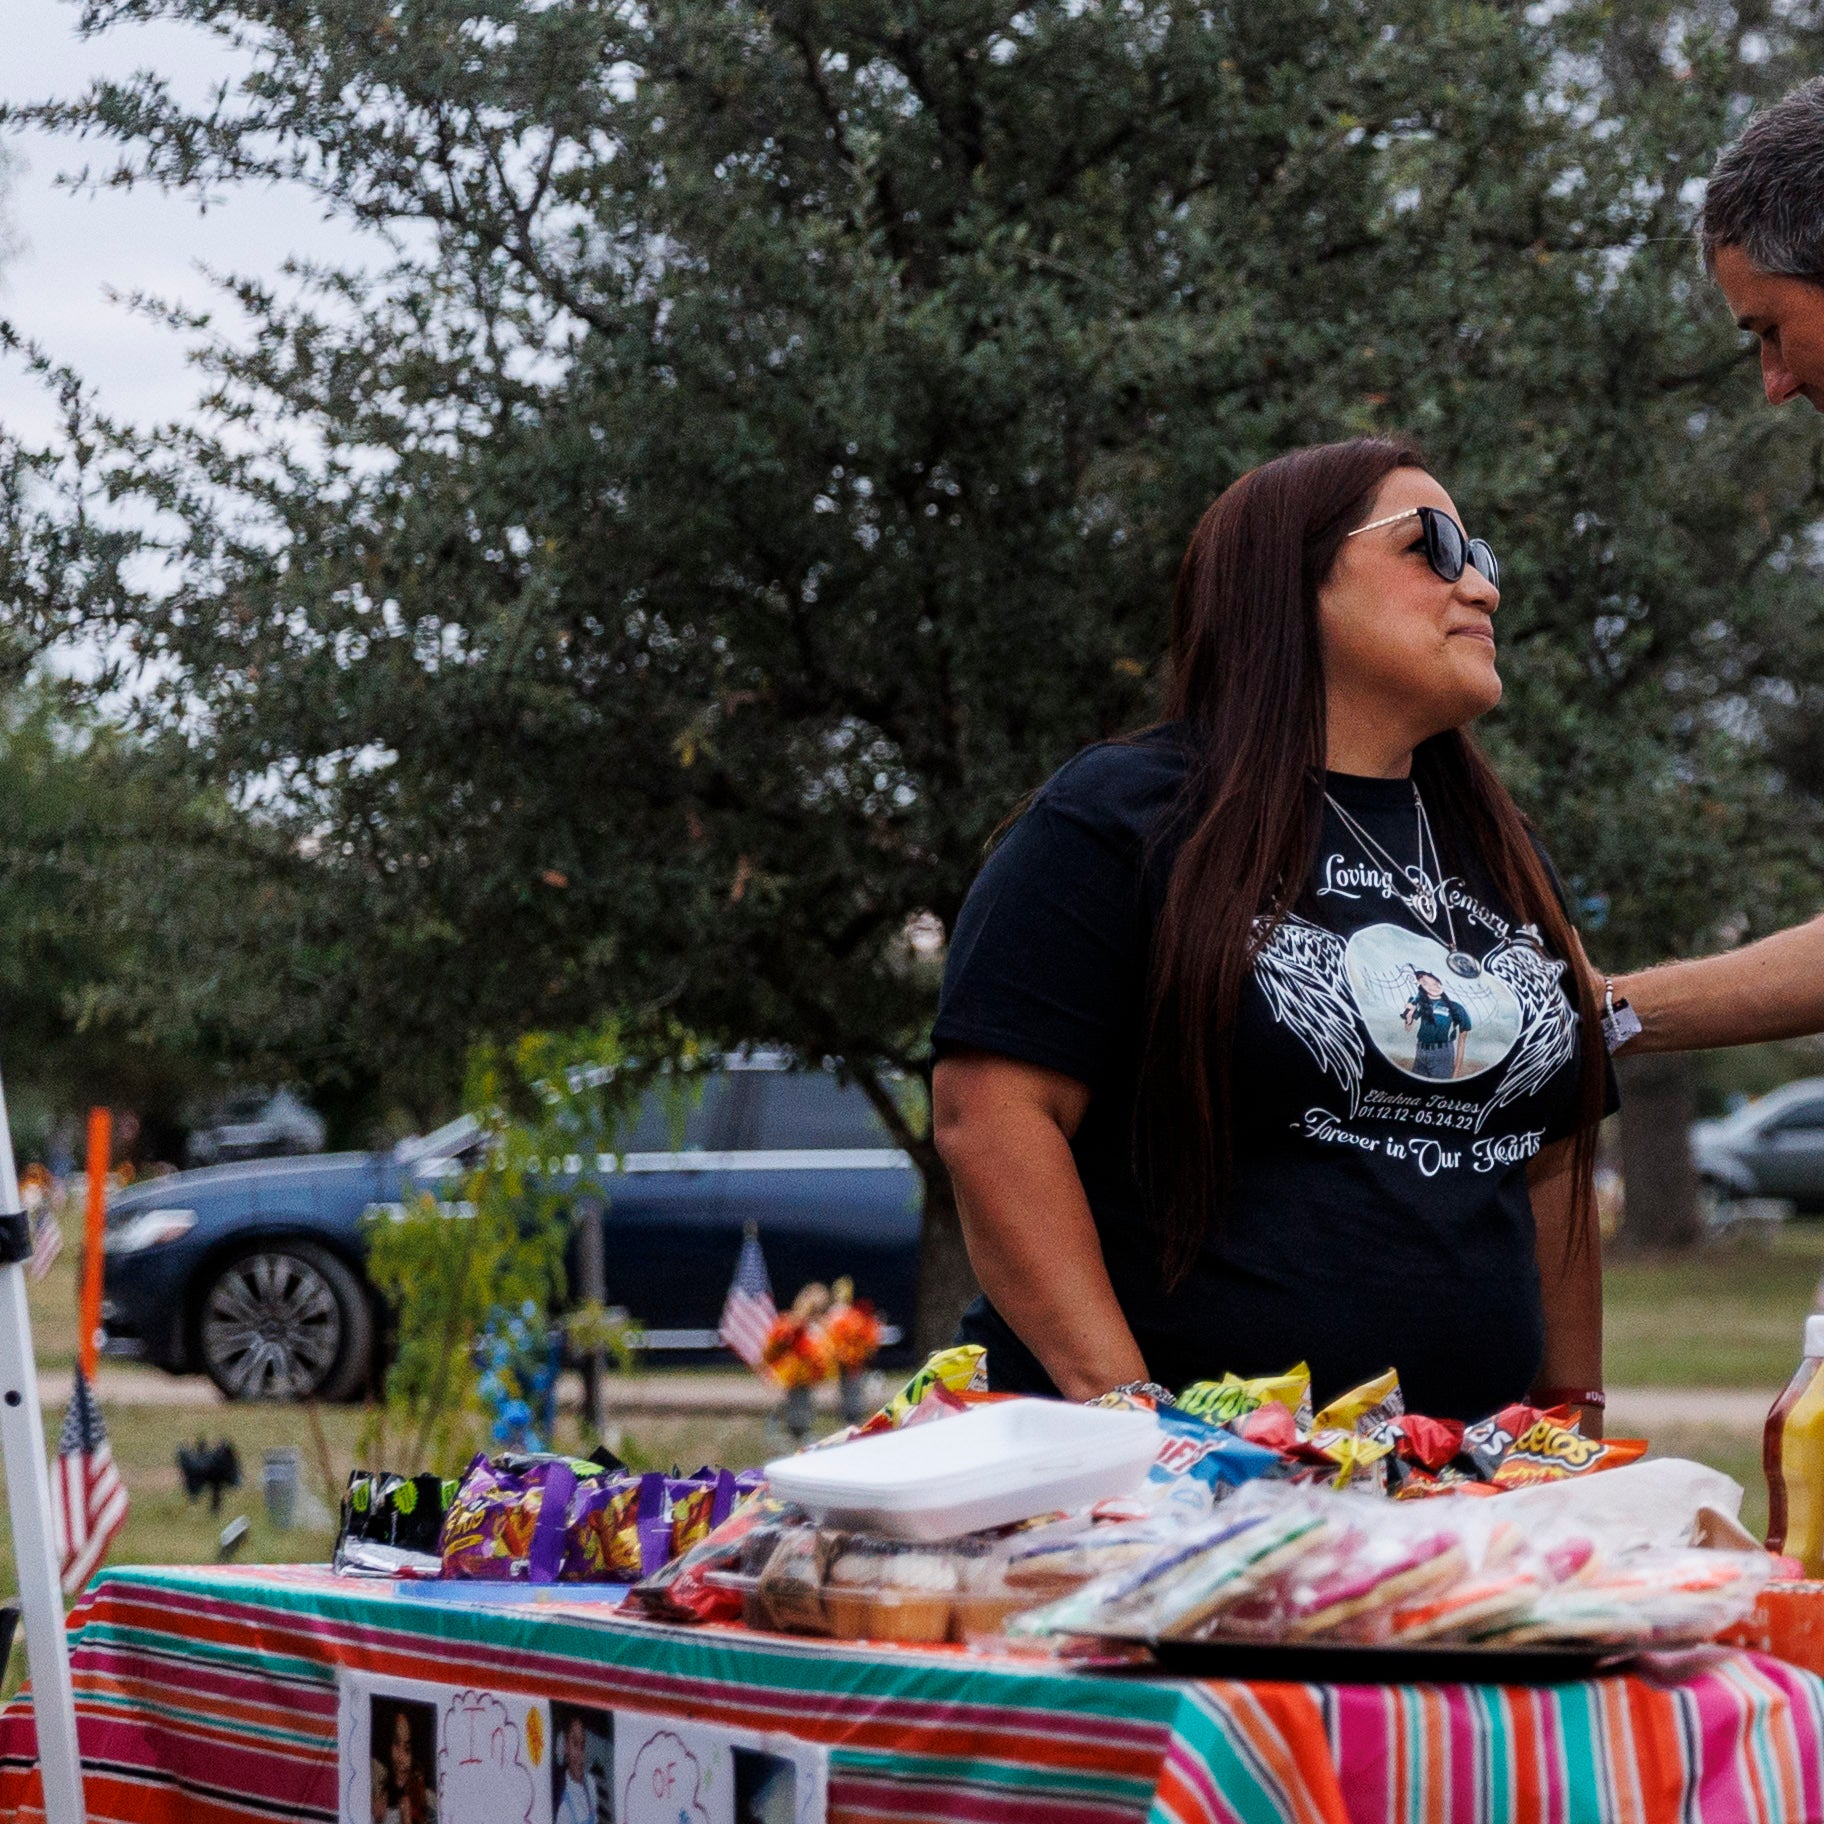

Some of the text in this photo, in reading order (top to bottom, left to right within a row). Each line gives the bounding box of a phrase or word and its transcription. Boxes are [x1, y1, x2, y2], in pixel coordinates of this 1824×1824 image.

[1316, 853, 1511, 939] Loving Memory
[1358, 1105, 1474, 1131] 01.12.12-05.24.22
[1363, 1088, 1482, 1114] Eliahna Torres
[1303, 1106, 1547, 1177] Forever in Our Hearts
[459, 1706, 506, 1769] In
